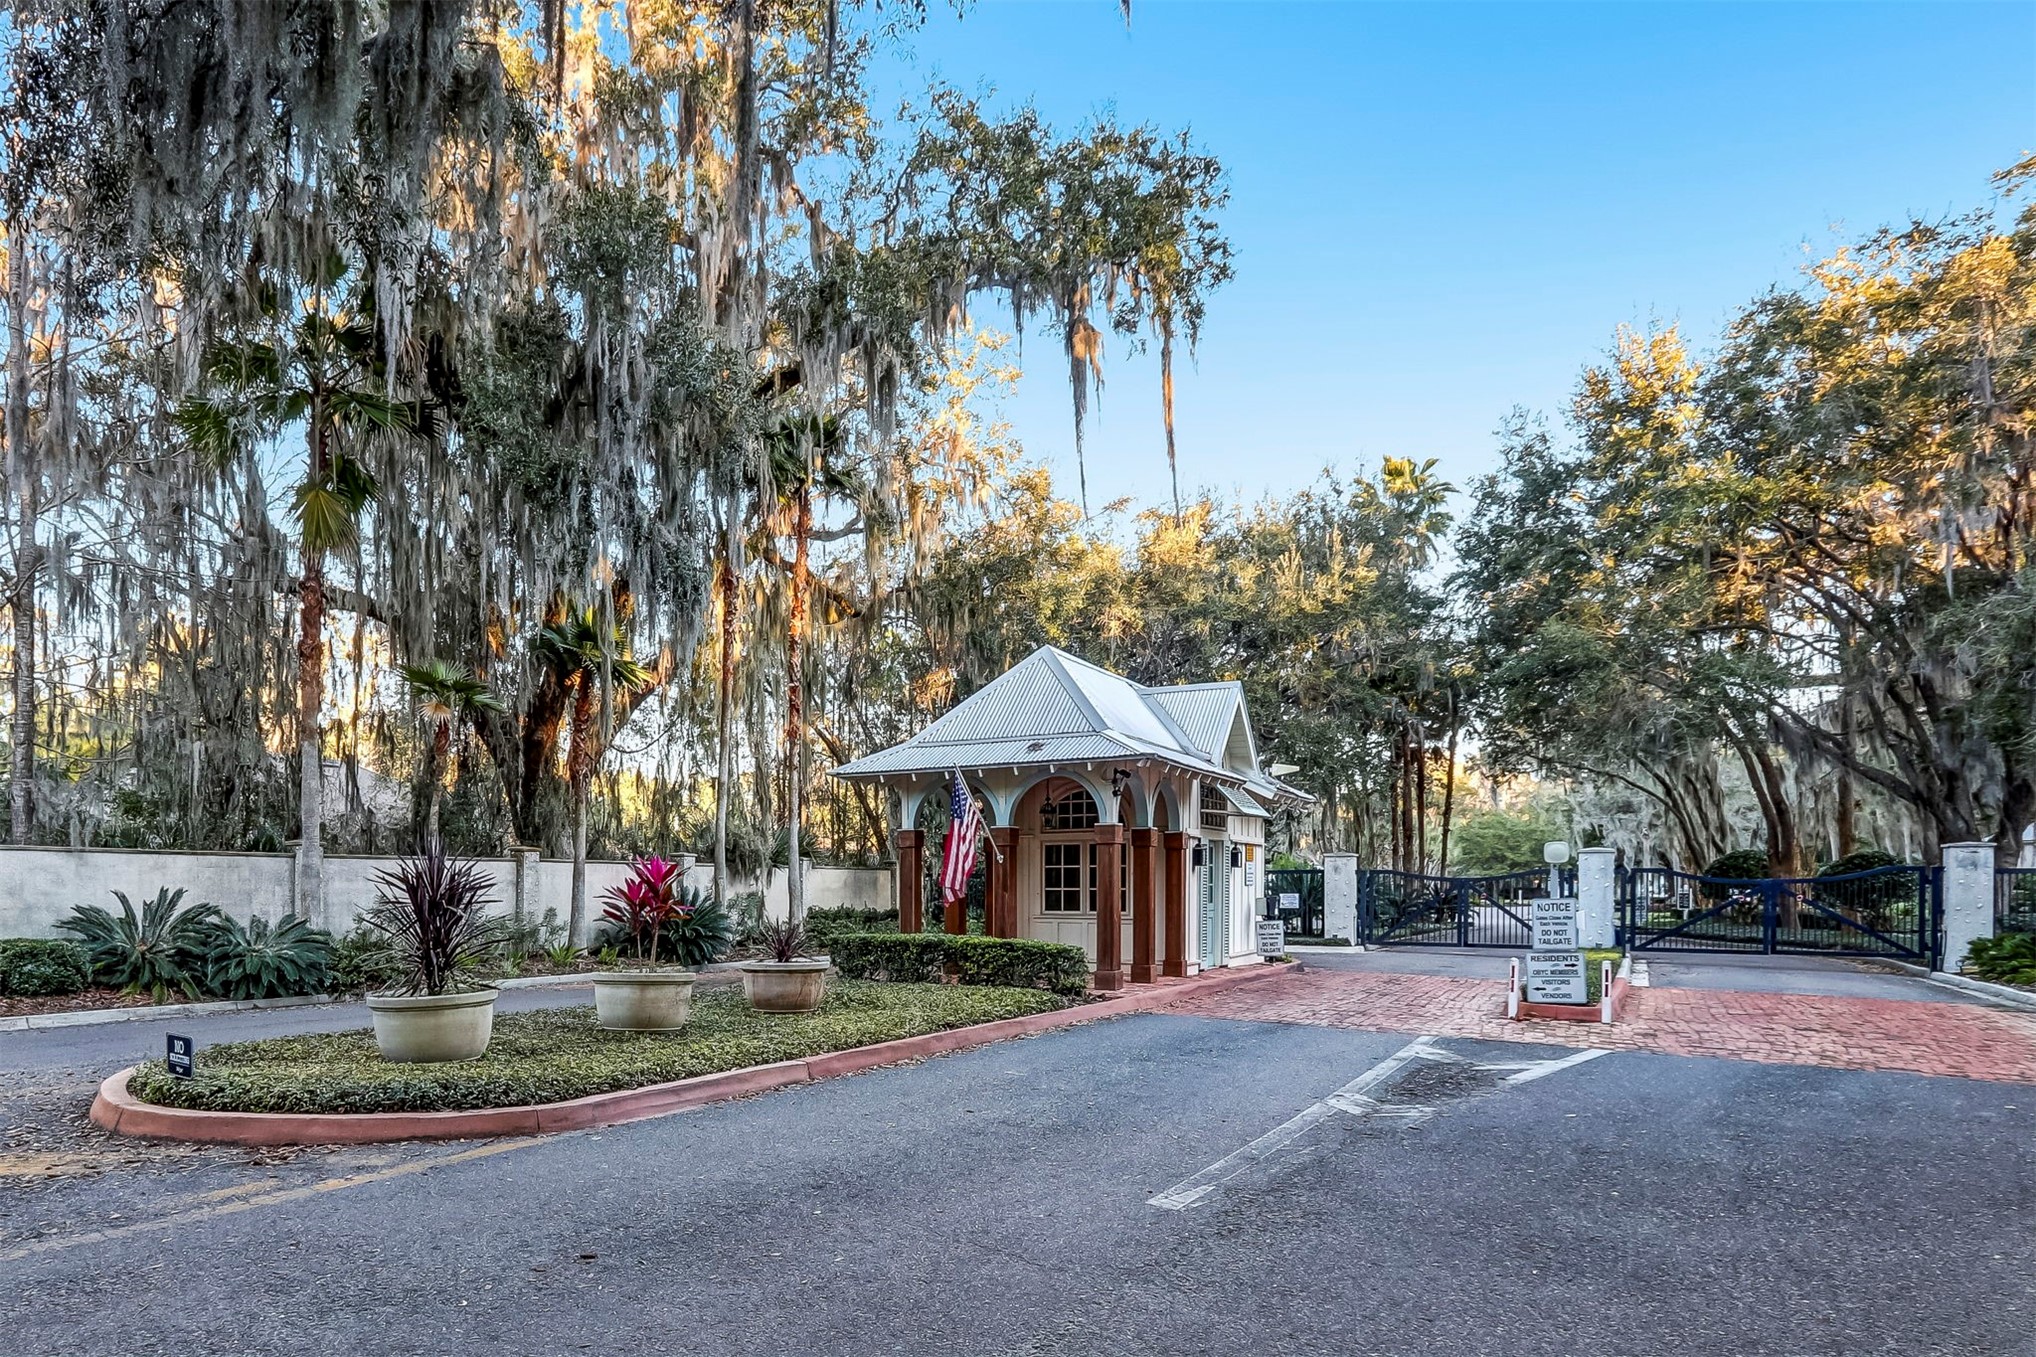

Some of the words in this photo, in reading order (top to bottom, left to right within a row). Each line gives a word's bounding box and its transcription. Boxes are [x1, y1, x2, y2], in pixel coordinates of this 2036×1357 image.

[1537, 902, 1571, 912] NOTICE
[1538, 938, 1572, 946] TAILGATE
[1530, 954, 1580, 962] RESIDENTS
[174, 1040, 184, 1054] NO
